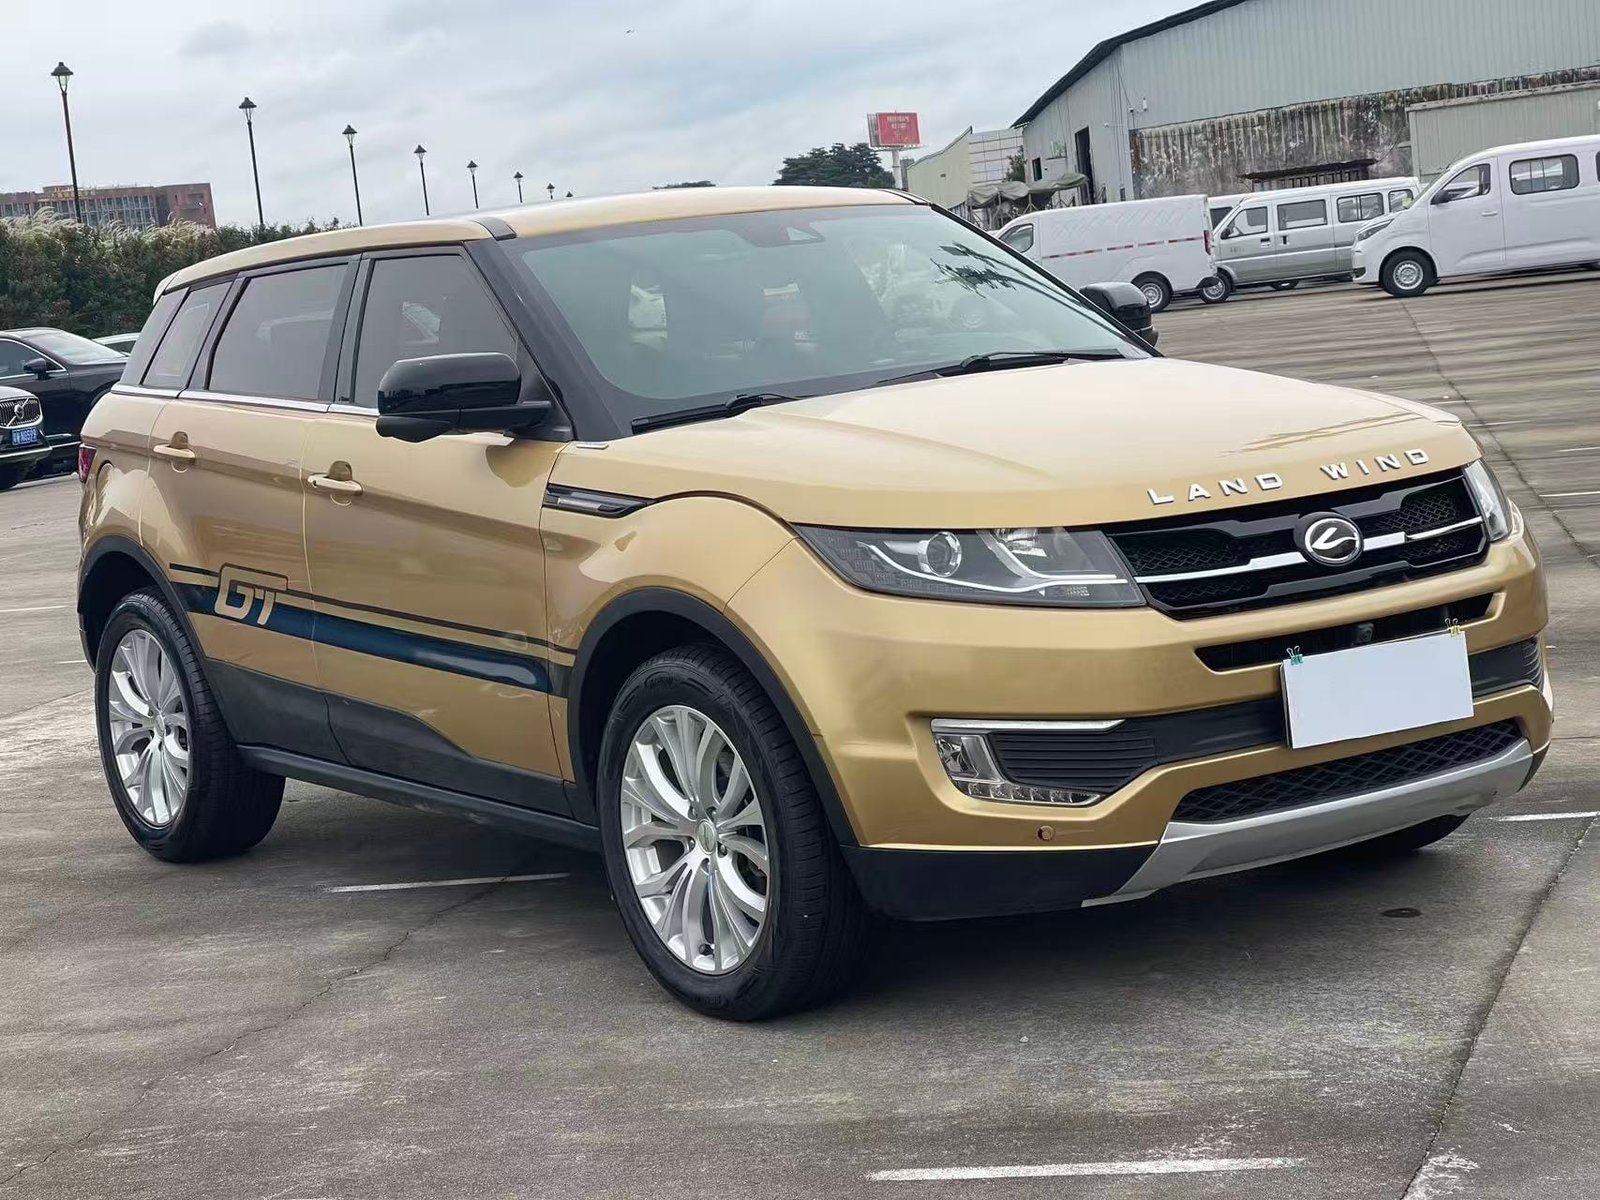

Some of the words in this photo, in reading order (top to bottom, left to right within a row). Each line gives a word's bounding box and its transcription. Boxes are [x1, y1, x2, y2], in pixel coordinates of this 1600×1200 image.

[1147, 472, 1283, 504] LAND
[1320, 448, 1430, 480] WIND
[215, 563, 288, 626] GT
